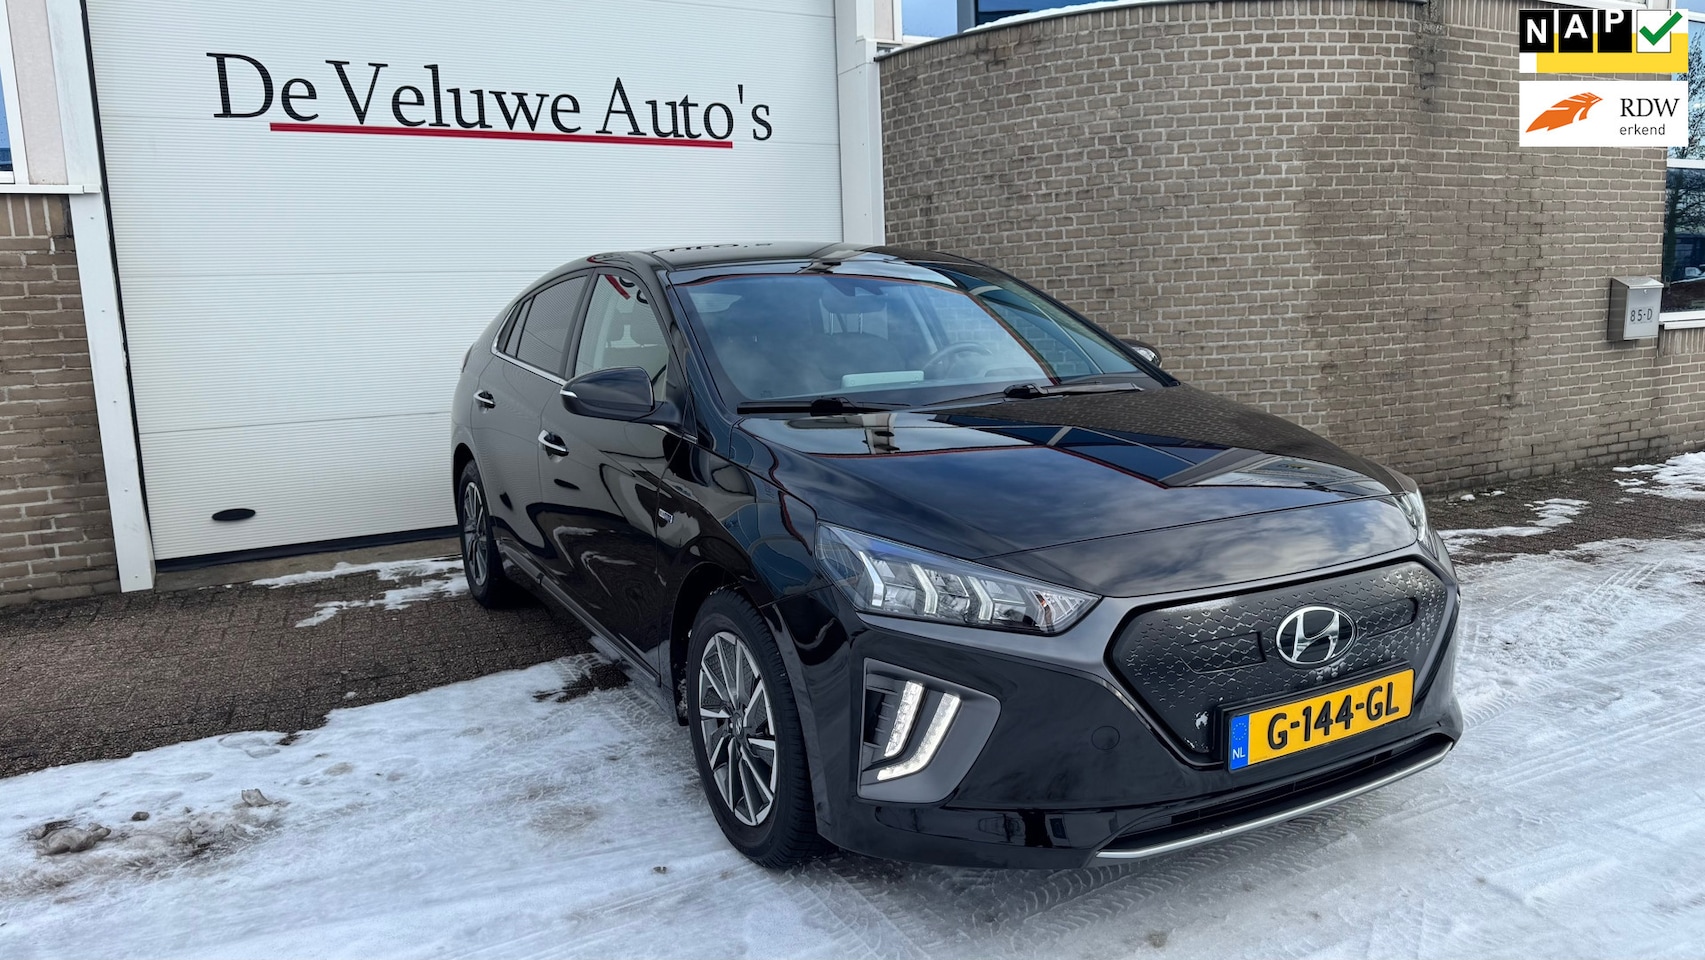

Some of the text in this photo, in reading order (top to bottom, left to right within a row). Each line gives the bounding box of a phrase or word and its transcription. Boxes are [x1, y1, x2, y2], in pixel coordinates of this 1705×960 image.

[206, 52, 773, 141] De Veluwe Auto's
[1267, 682, 1400, 750] G-144-GL
[1232, 747, 1246, 760] NL
